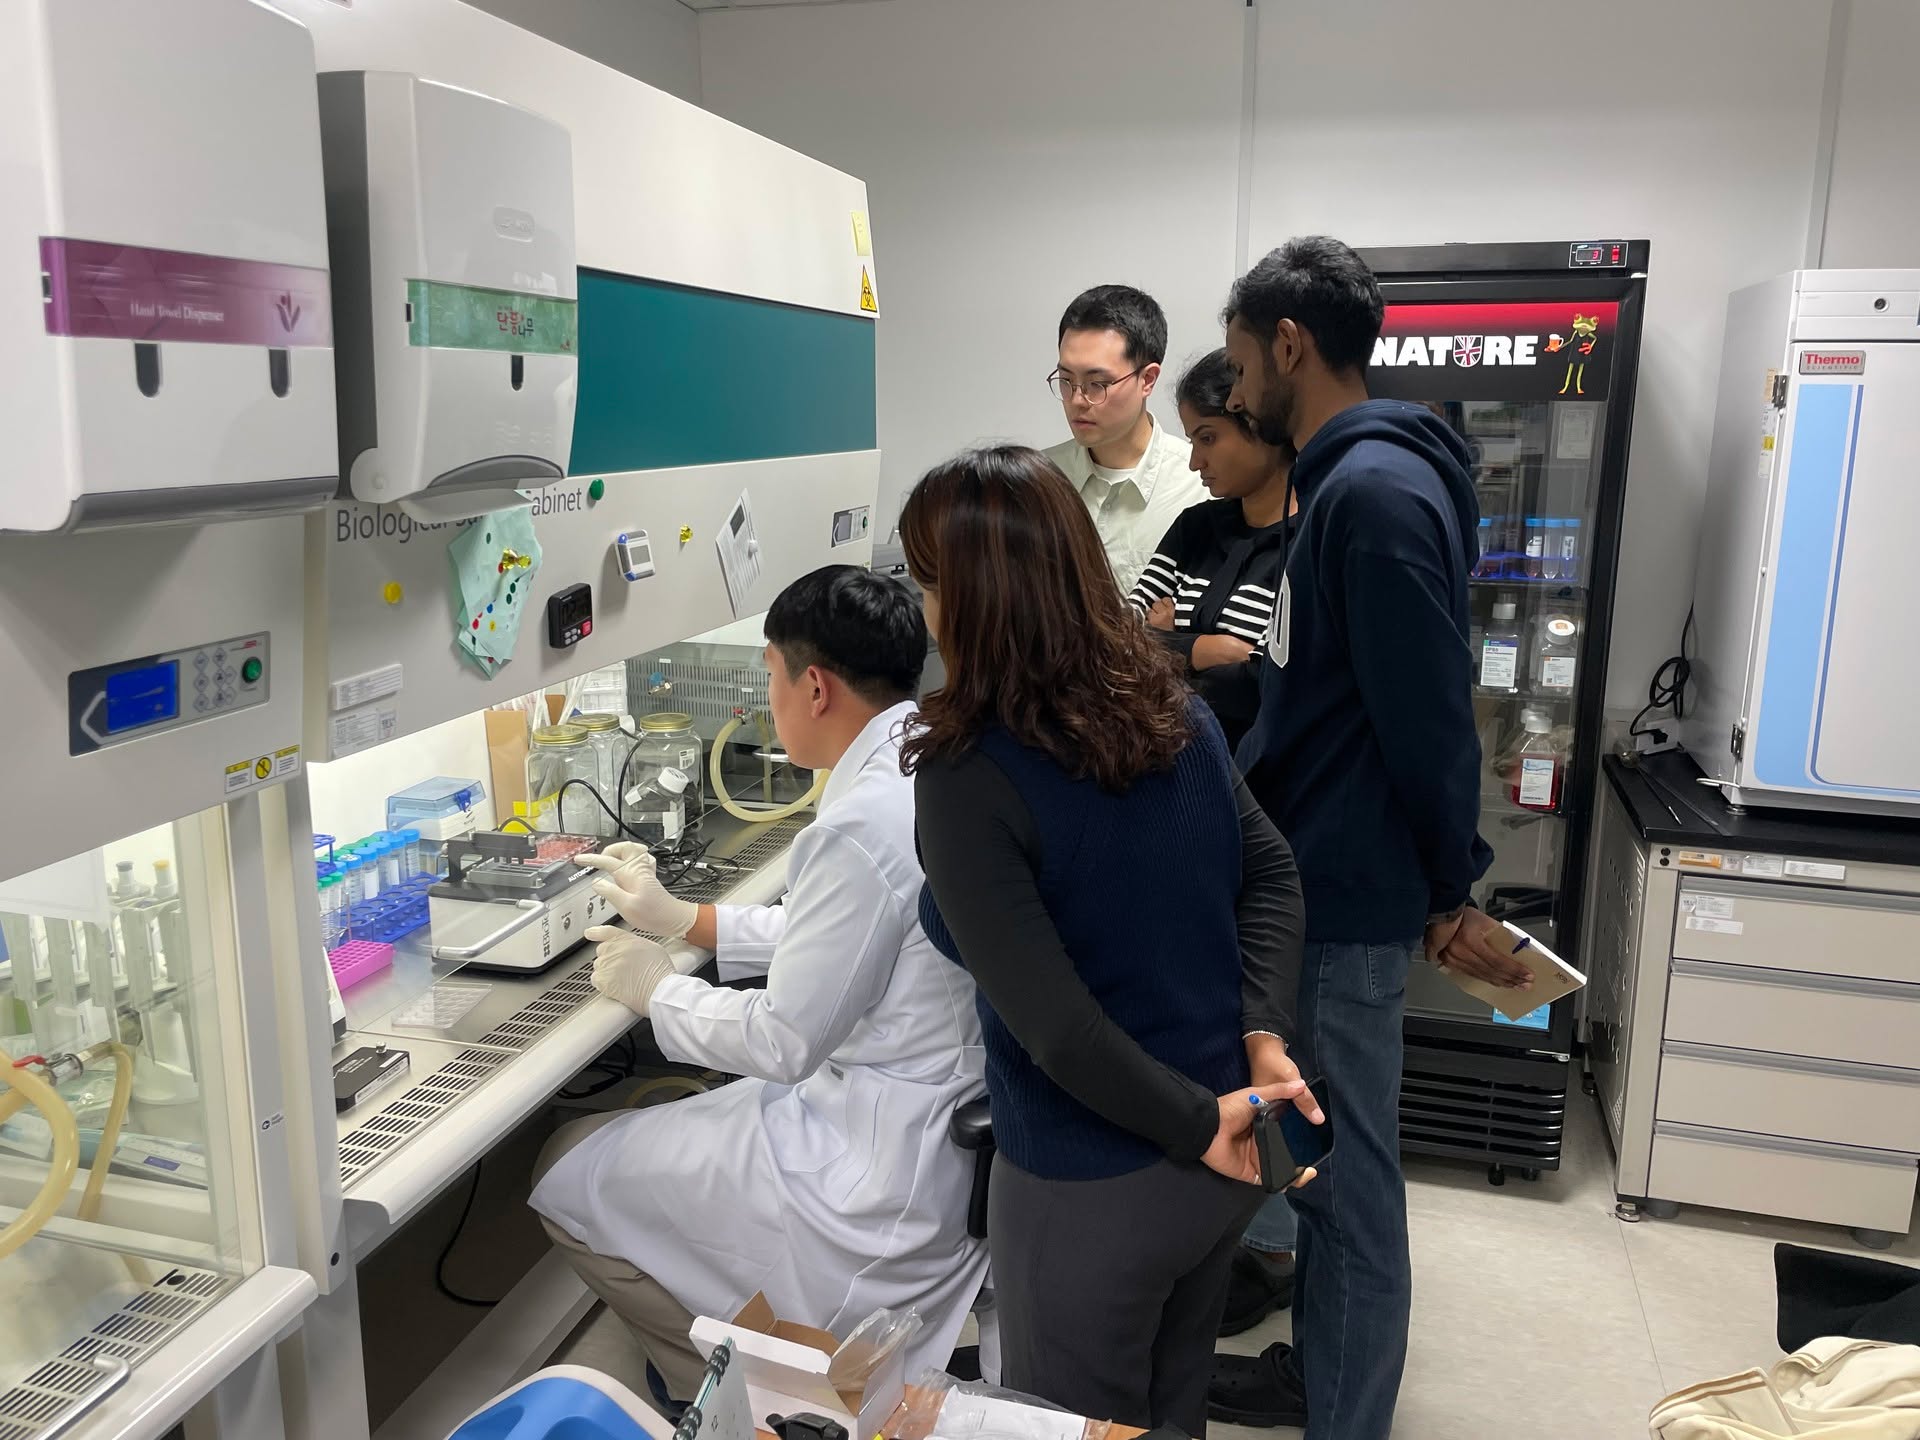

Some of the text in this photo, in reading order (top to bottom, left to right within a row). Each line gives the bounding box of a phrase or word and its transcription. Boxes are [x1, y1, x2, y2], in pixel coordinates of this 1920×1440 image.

[130, 302, 224, 324] Hand Towel Dispenser
[497, 311, 534, 338] 단풍나무
[1805, 353, 1860, 365] Thermo
[336, 487, 582, 543] Biolog abinet
